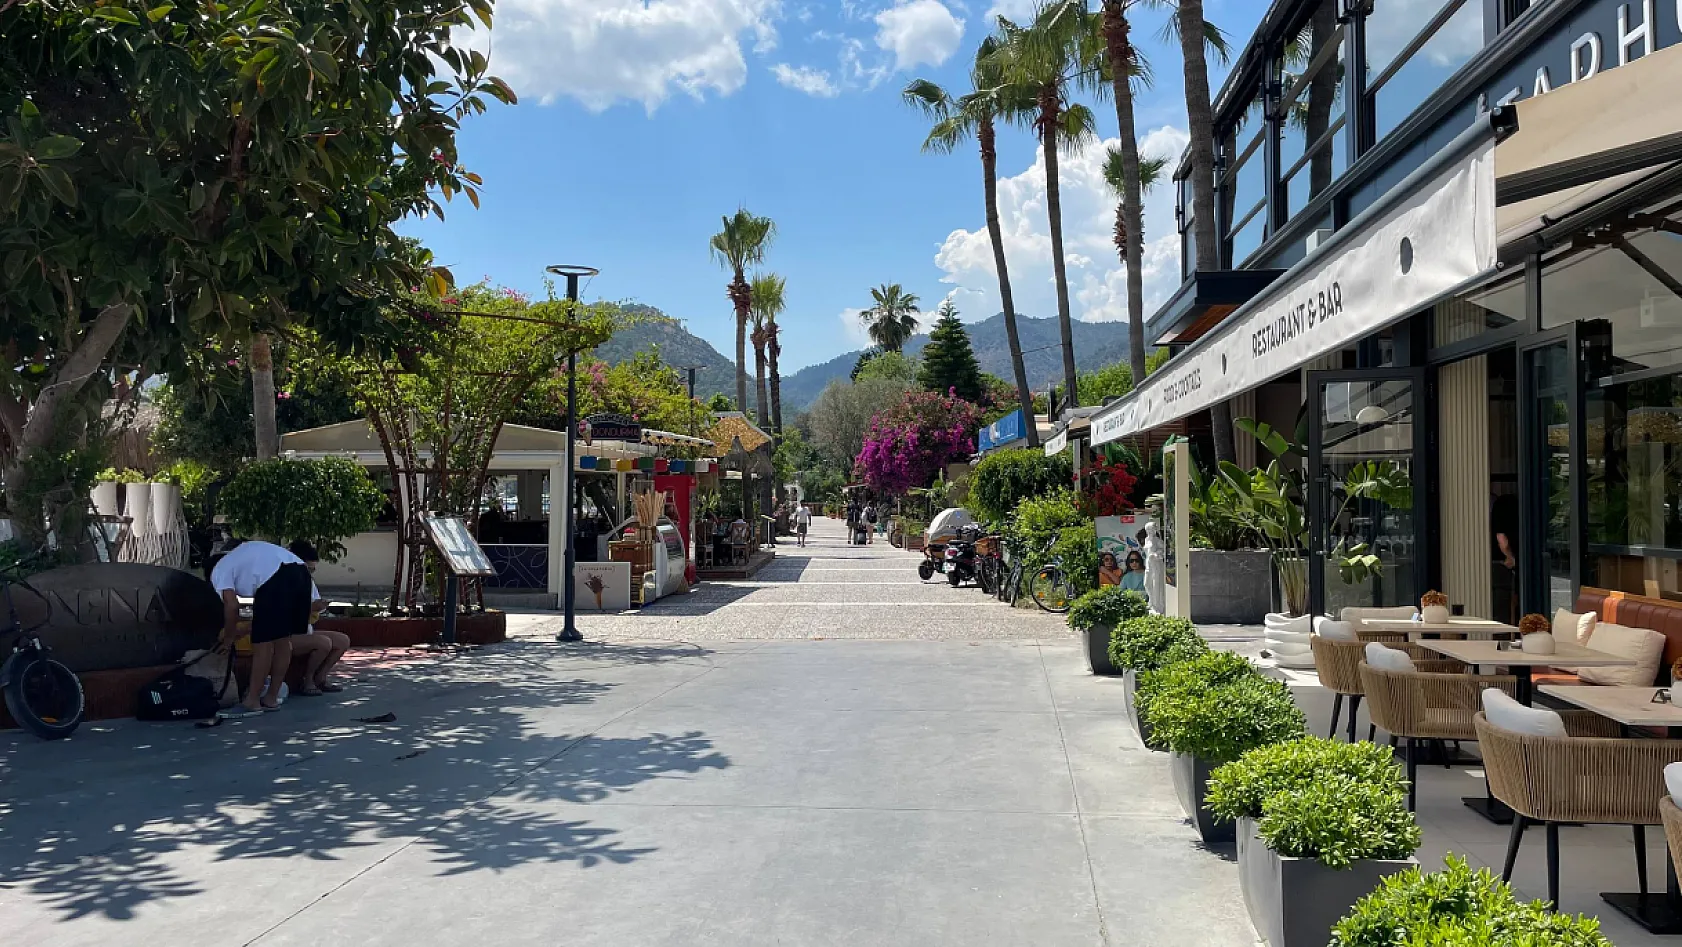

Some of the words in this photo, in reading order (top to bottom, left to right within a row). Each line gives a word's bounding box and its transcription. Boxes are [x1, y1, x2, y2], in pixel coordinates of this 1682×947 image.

[1252, 304, 1305, 359] RESTAURANT
[1308, 298, 1316, 329] &
[1319, 282, 1343, 323] BAR
